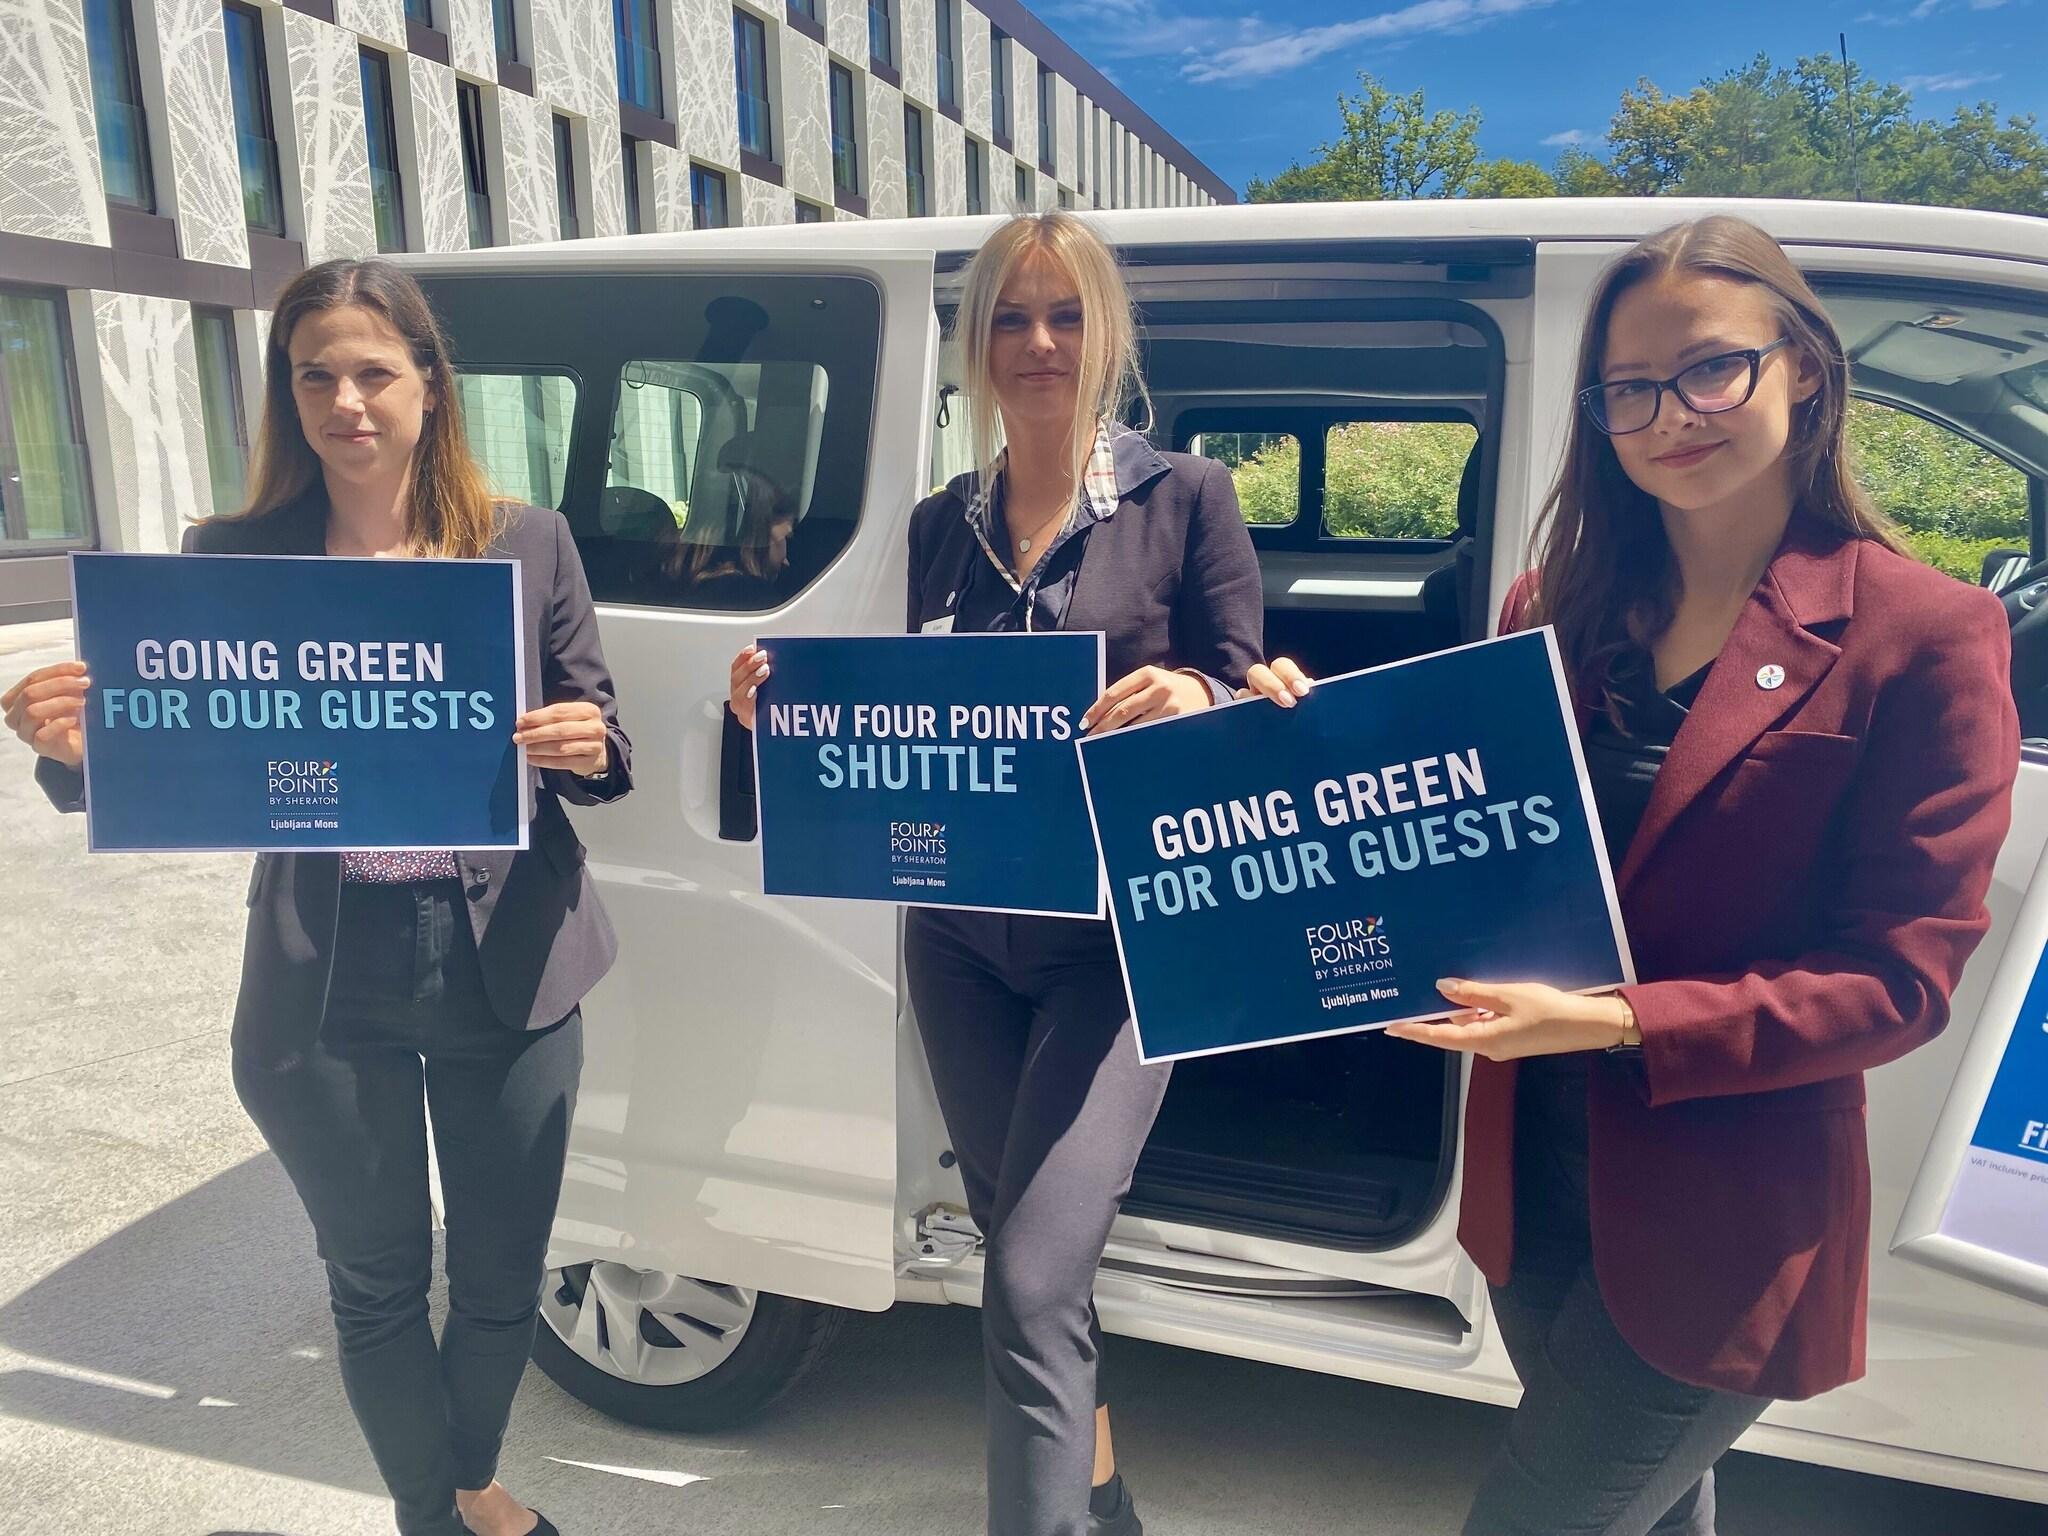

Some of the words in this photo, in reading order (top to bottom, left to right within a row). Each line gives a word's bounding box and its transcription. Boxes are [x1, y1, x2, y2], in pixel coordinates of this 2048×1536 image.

[135, 639, 281, 681] GOING
[297, 641, 444, 682] GREEN
[103, 688, 191, 729] FOR
[208, 688, 304, 729] OUR
[320, 688, 495, 730] GUESTS
[770, 704, 841, 737] NEW
[854, 704, 938, 739] FOUR
[950, 705, 1072, 741] POINTS
[267, 760, 322, 777] FOUR
[818, 743, 1017, 793] SHUTTLE
[268, 778, 339, 794] POINTS
[269, 797, 282, 805] BY
[285, 797, 338, 805] SHERATON
[1152, 790, 1300, 860] GOING
[1313, 747, 1487, 827] GREEN
[270, 819, 312, 831] Ljubljana
[314, 819, 339, 829] Mons
[890, 822, 933, 838] FOUR
[891, 837, 946, 854] POINTS
[891, 855, 902, 863] BY
[904, 855, 946, 865] SHERATON
[1127, 864, 1219, 922] FOR
[1231, 841, 1337, 901] OUR
[1349, 795, 1560, 878] GUESTS
[892, 875, 925, 887] Ljubljana
[926, 877, 946, 887] Mons
[1305, 919, 1368, 946] FOUR
[1310, 935, 1391, 967] POINTS
[1314, 969, 1329, 981] BY
[1332, 958, 1394, 978] SHERATON
[1320, 992, 1369, 1011] Ljubljana
[1370, 987, 1400, 1001] Mons
[1971, 1157, 1987, 1167] VAT
[1989, 1161, 2028, 1178] inclusive
